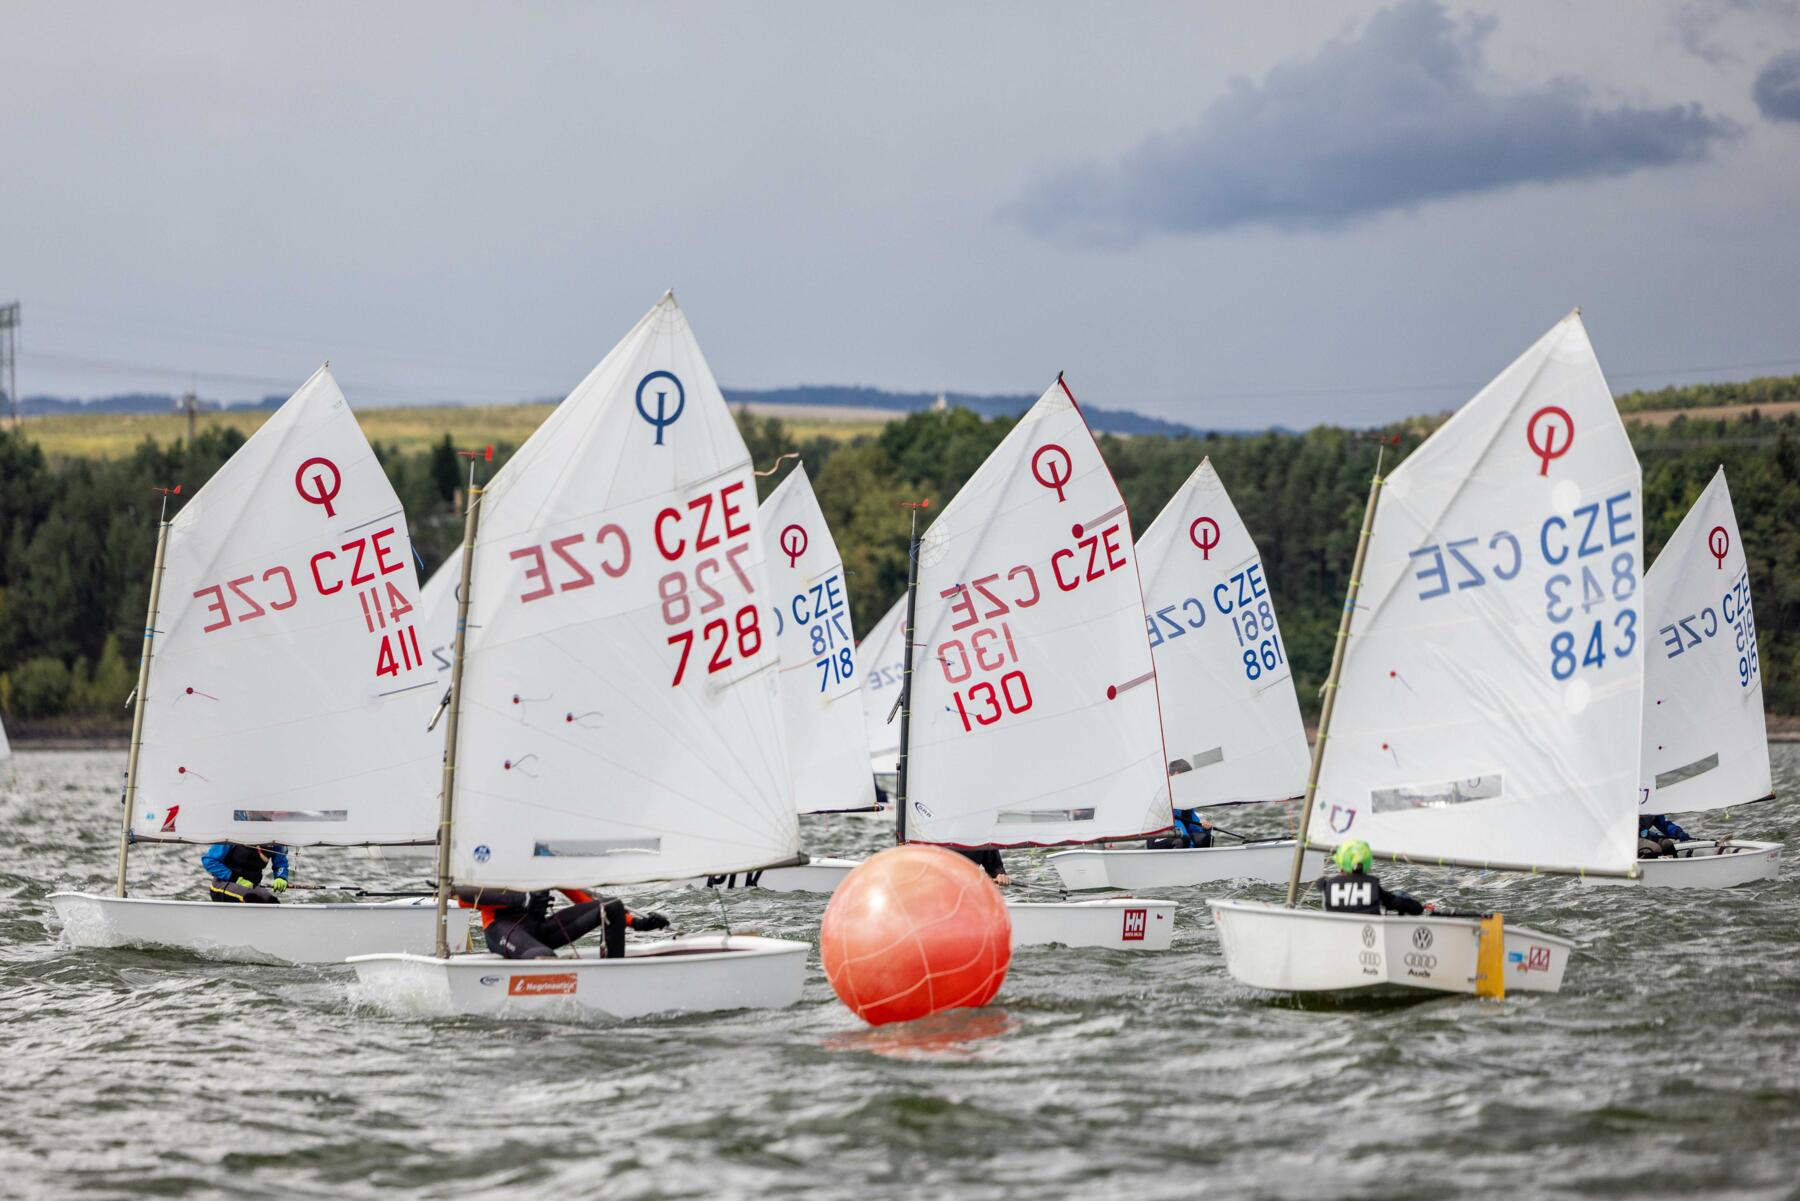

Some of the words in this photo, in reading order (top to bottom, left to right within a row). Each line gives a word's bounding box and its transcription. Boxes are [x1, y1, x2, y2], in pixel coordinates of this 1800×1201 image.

[655, 481, 750, 561] CZE
[1540, 491, 1636, 566] CZE
[310, 527, 405, 596] CZE
[1051, 524, 1127, 592] CZE
[792, 575, 843, 625] CZE
[1213, 563, 1267, 615] CZE
[1723, 572, 1750, 624] CZE
[376, 625, 423, 677] 411
[667, 604, 762, 687] 728
[816, 647, 853, 693] 718
[1243, 634, 1284, 680] 861
[1550, 608, 1637, 681] 843
[1740, 641, 1757, 687] 915
[953, 670, 1033, 732] 130
[1331, 882, 1371, 907] HH
[1125, 912, 1144, 931] HH
[1408, 968, 1431, 978] Audi
